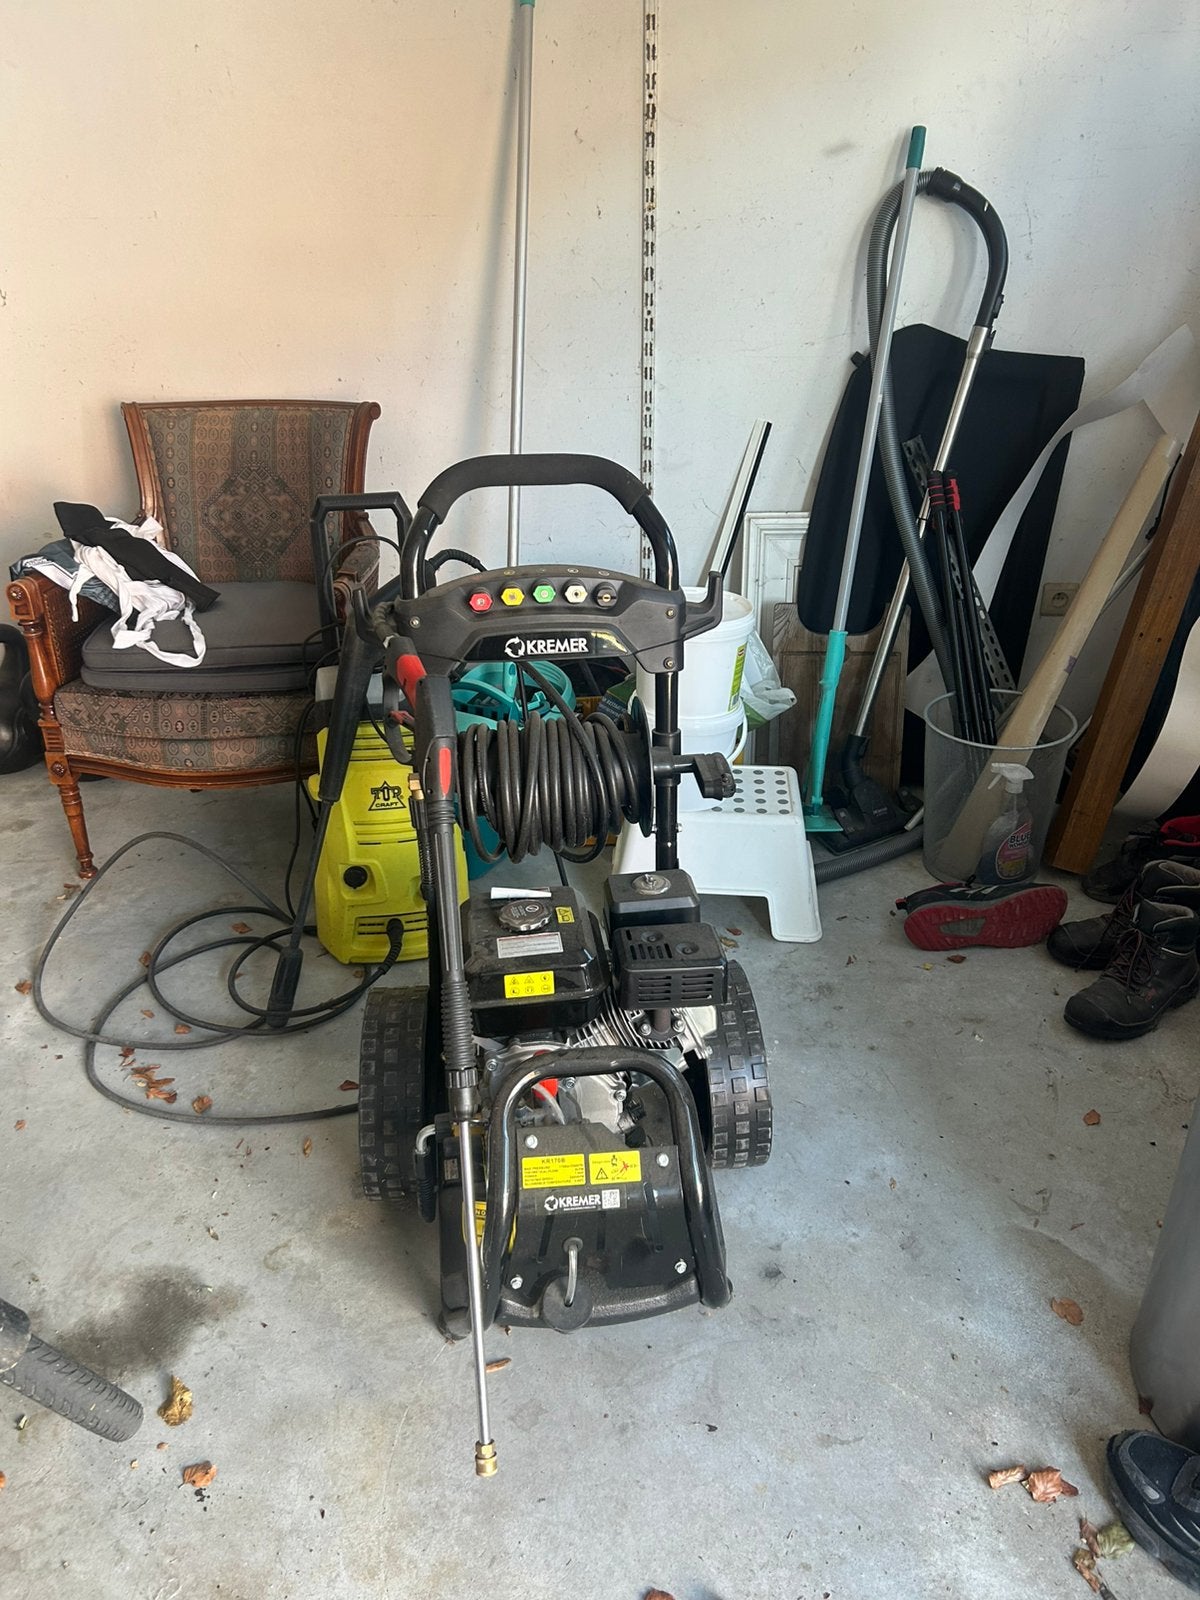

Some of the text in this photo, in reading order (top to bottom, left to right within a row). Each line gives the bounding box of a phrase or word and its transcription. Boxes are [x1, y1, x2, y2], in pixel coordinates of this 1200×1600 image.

[527, 638, 589, 655] KREMER
[371, 786, 402, 801] TOP
[558, 1194, 602, 1208] KREMER
